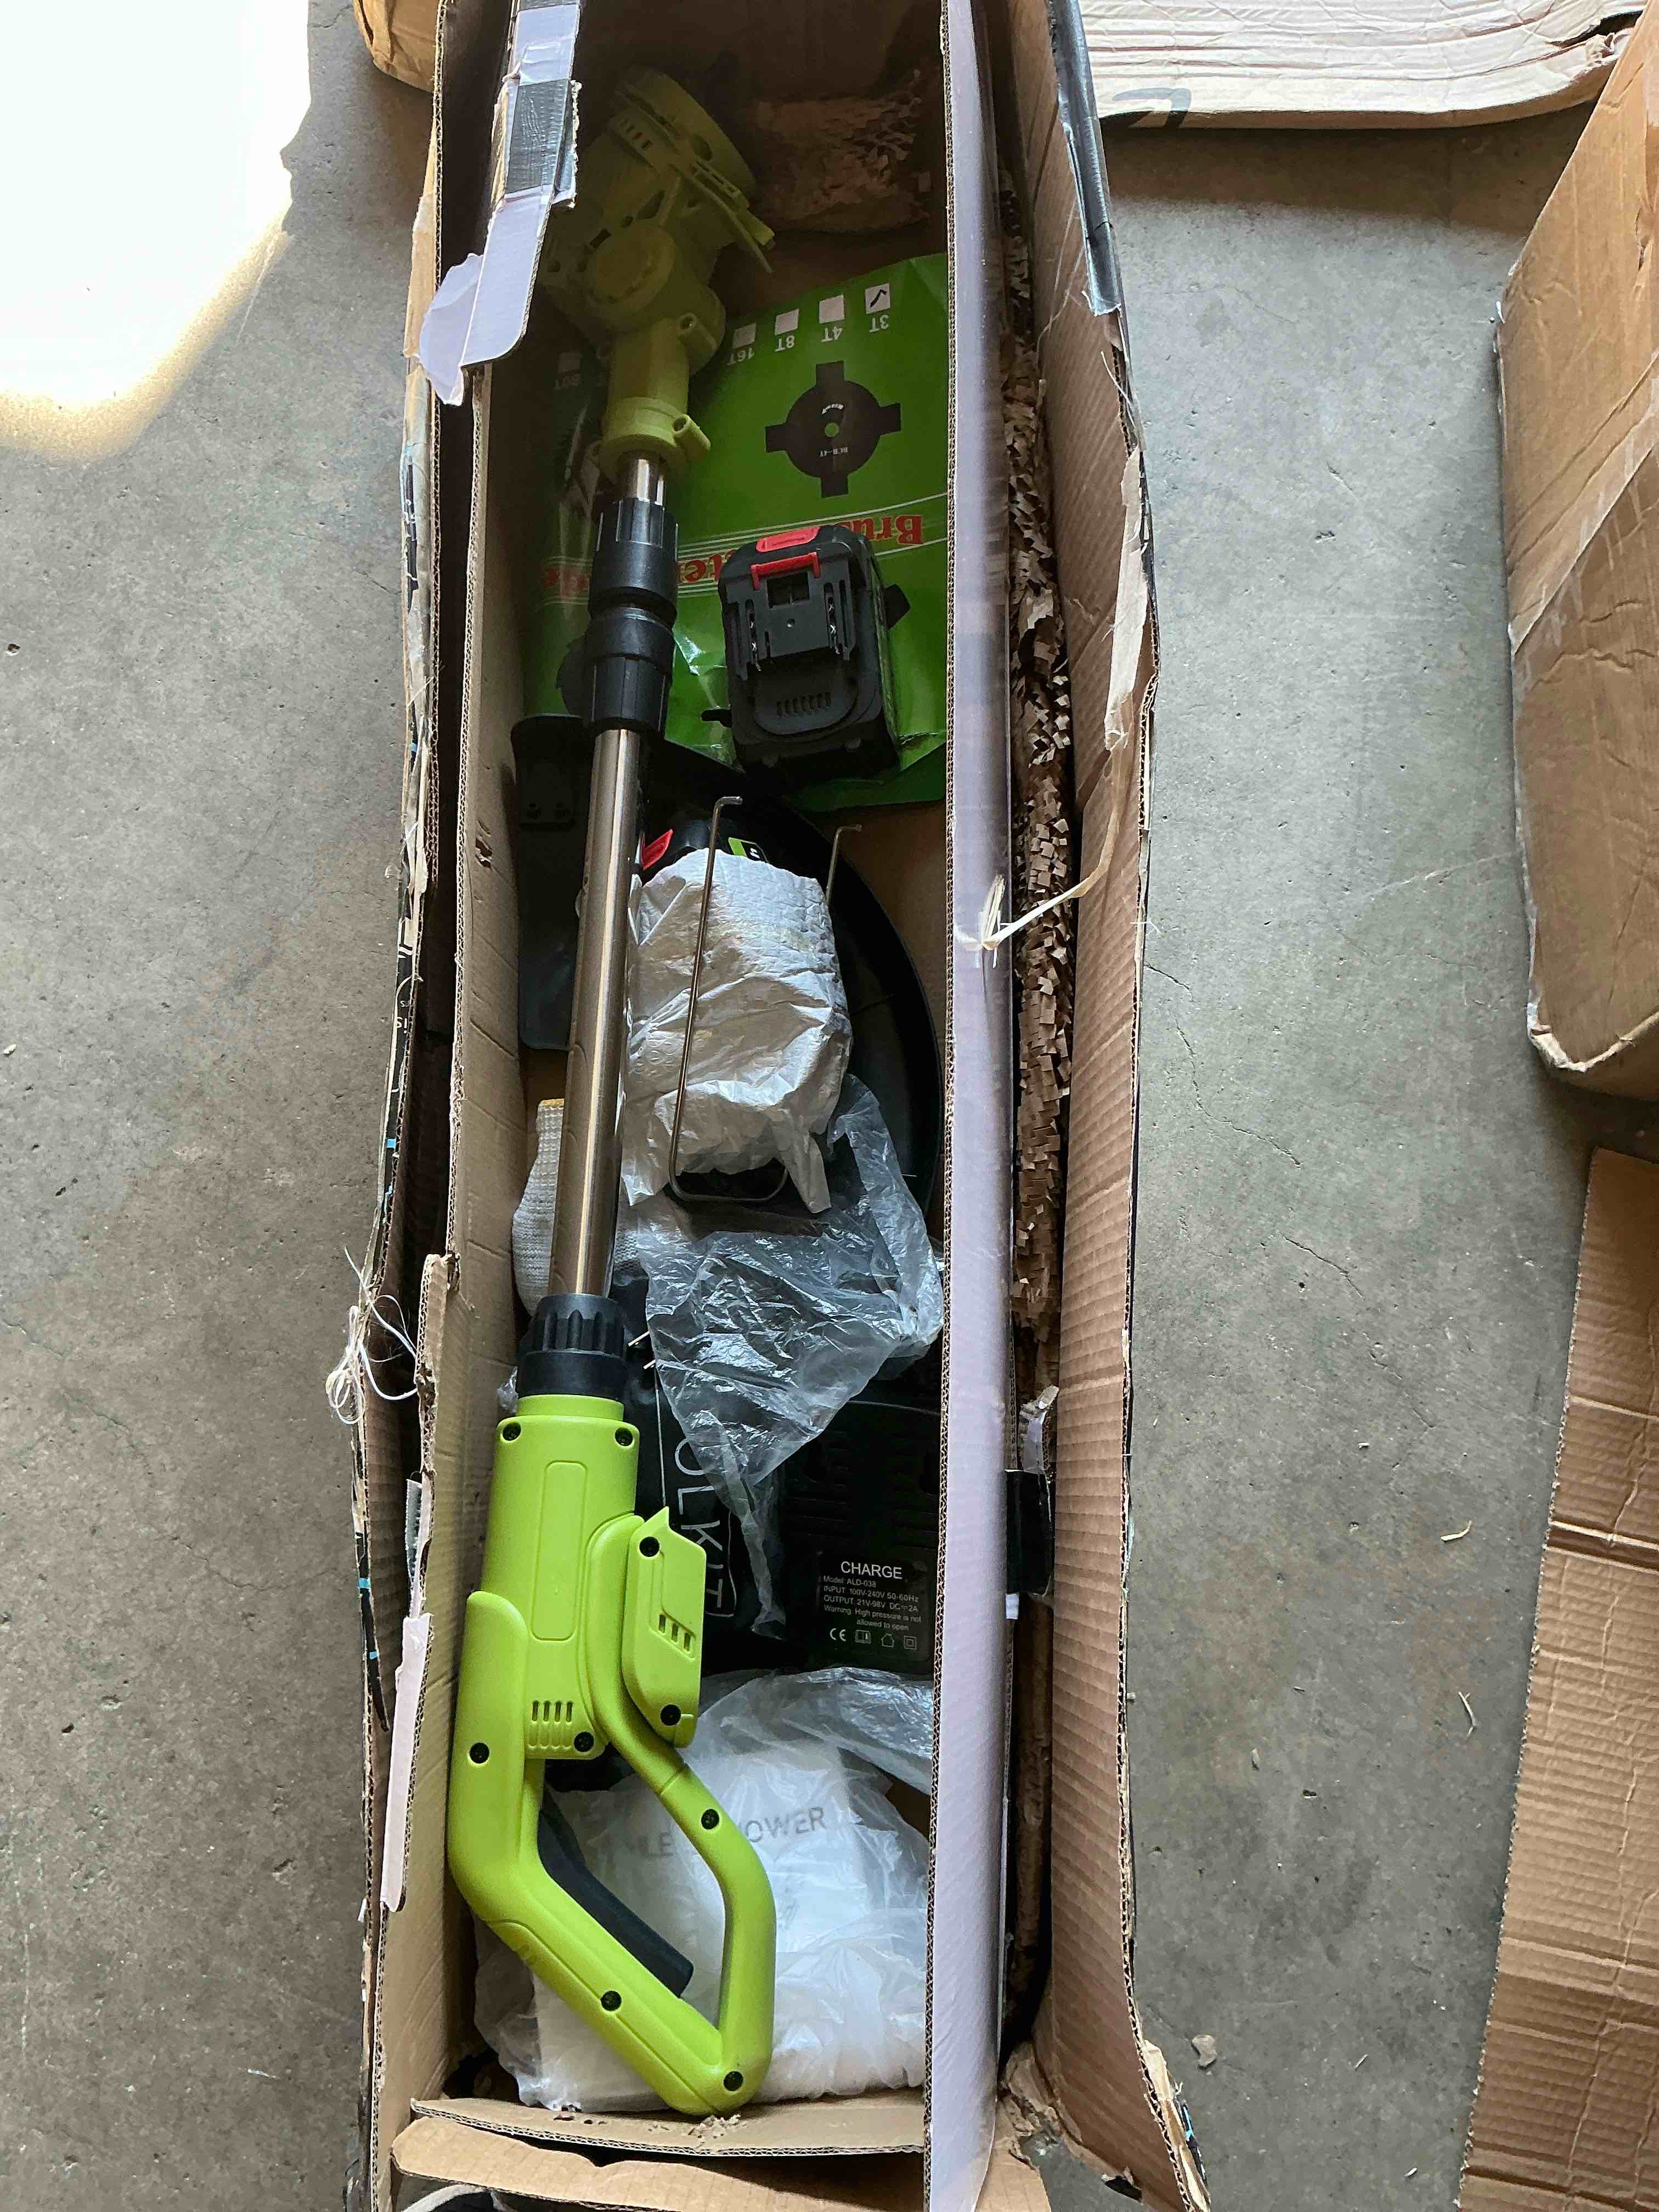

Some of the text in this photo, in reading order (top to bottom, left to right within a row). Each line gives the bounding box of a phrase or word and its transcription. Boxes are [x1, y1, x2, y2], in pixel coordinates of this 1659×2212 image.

[869, 314, 889, 332] 3T
[821, 326, 843, 342] 4T
[775, 335, 795, 352] 8T
[727, 347, 754, 366] 16T
[827, 514, 924, 545] Bru
[840, 1561, 902, 1579] CHARGE
[738, 1806, 826, 1843] OWER
